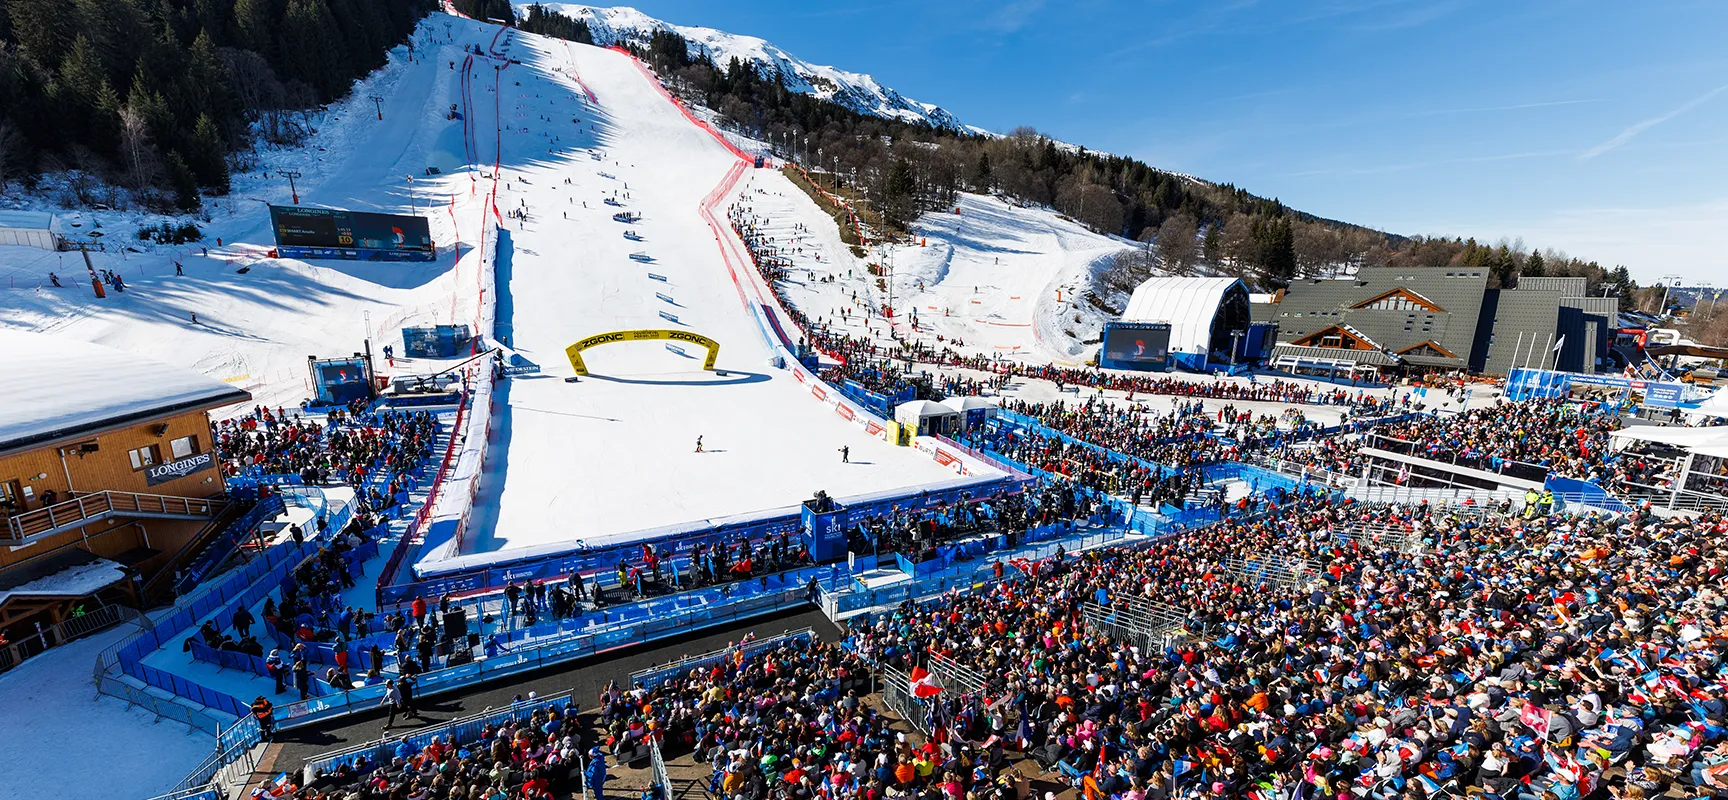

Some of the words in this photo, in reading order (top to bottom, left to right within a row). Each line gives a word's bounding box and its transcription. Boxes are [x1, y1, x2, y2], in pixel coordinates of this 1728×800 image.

[582, 334, 623, 348] ZGONC
[670, 332, 706, 344] ZGONC
[150, 454, 210, 478] LONGINES
[826, 516, 840, 533] ski
[502, 570, 515, 580] ski
